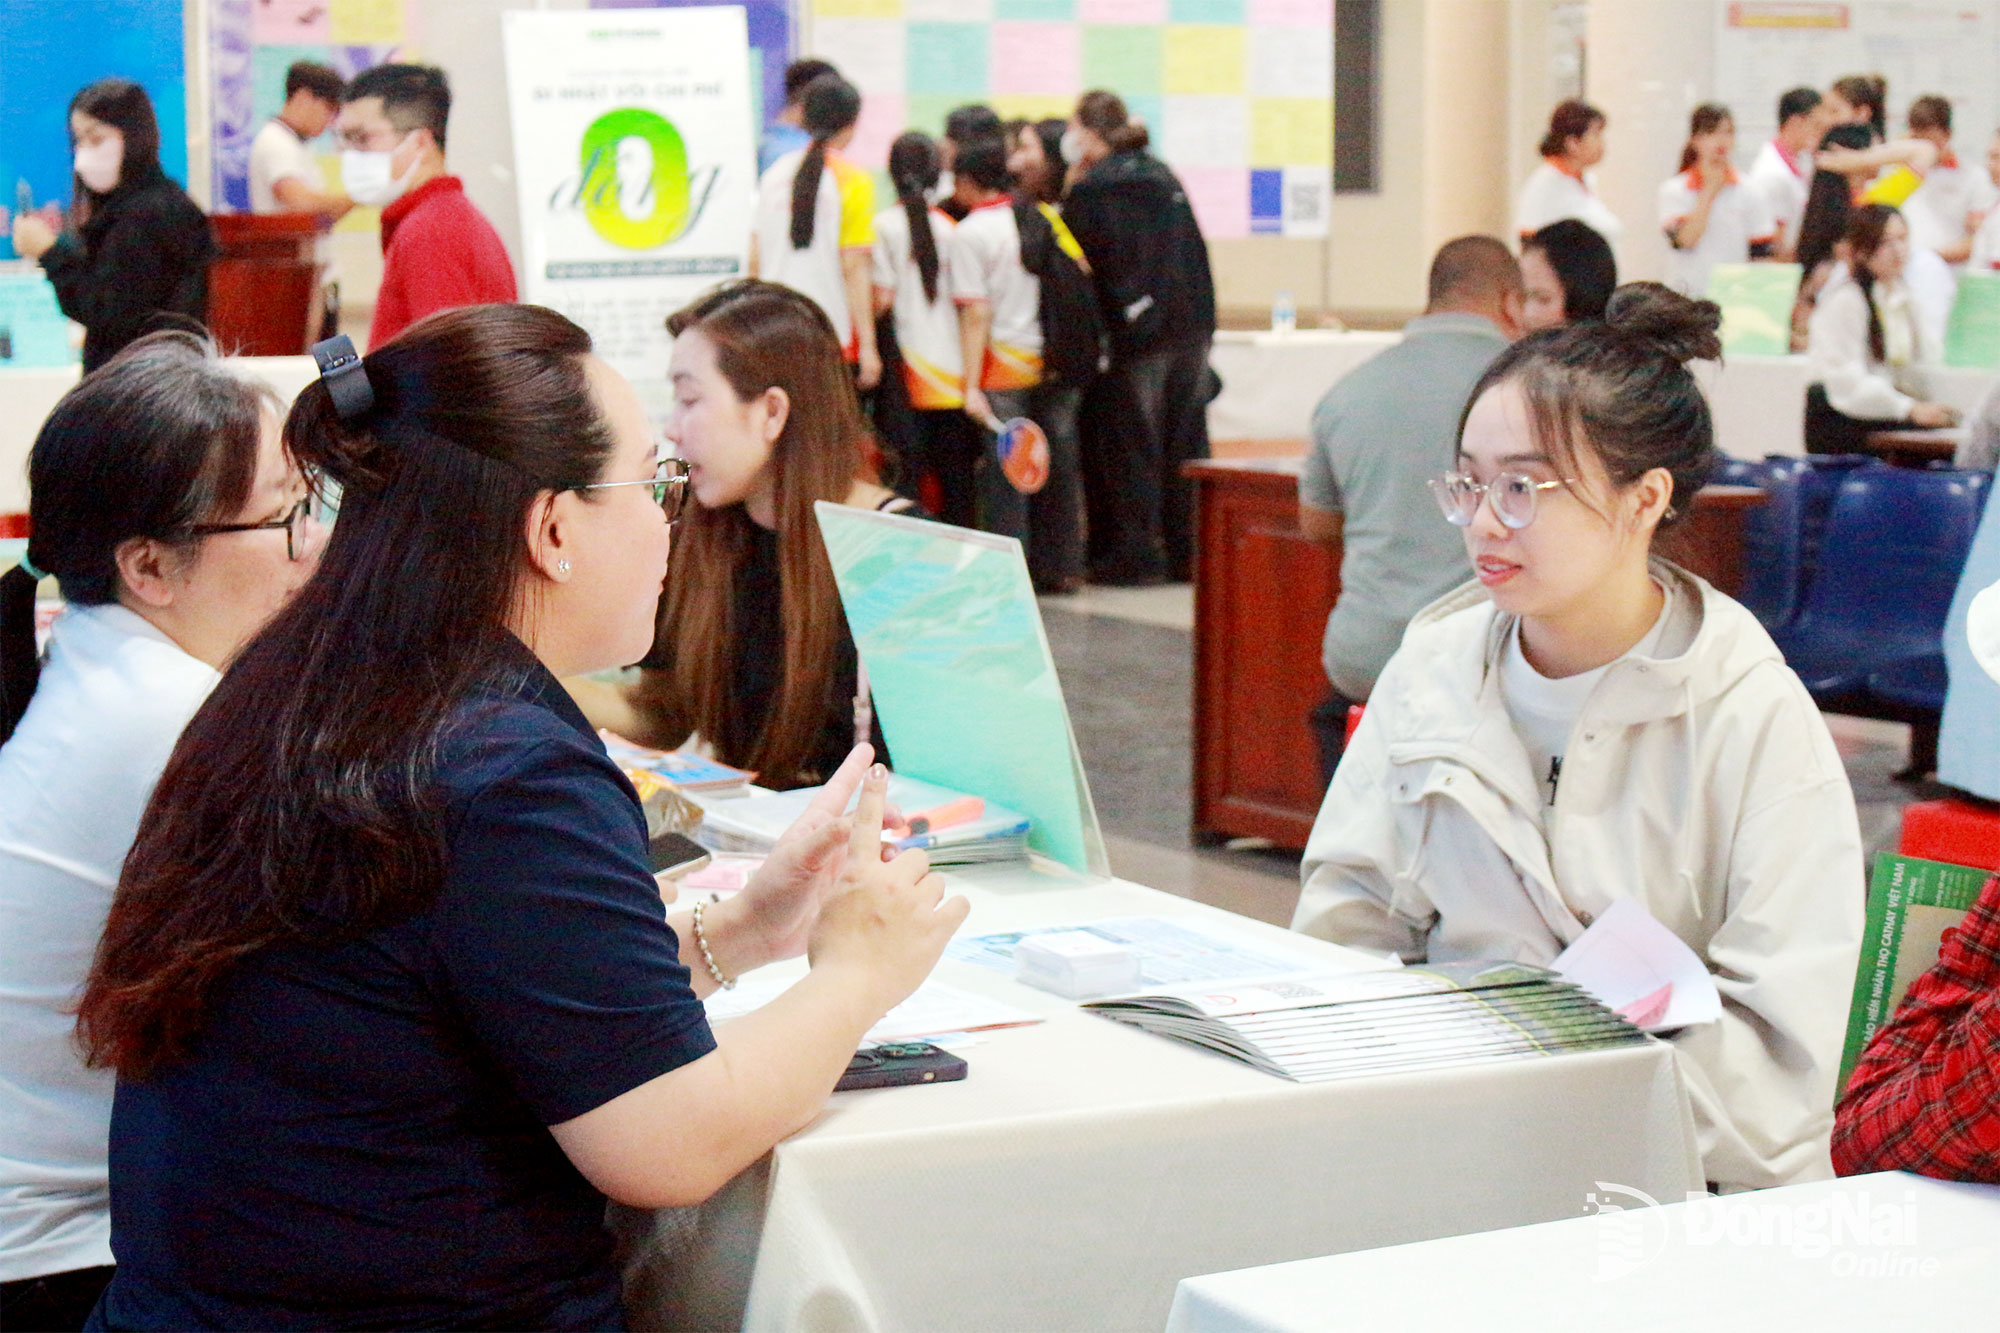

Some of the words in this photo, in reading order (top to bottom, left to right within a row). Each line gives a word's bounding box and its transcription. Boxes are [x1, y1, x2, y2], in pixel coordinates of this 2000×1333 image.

[1892, 862, 1905, 887] NAM
[1887, 888, 1901, 908] VIỆT
[1881, 910, 1896, 946] CATHAY
[1877, 948, 1891, 968] THỌ
[1872, 969, 1886, 998] NHÂN
